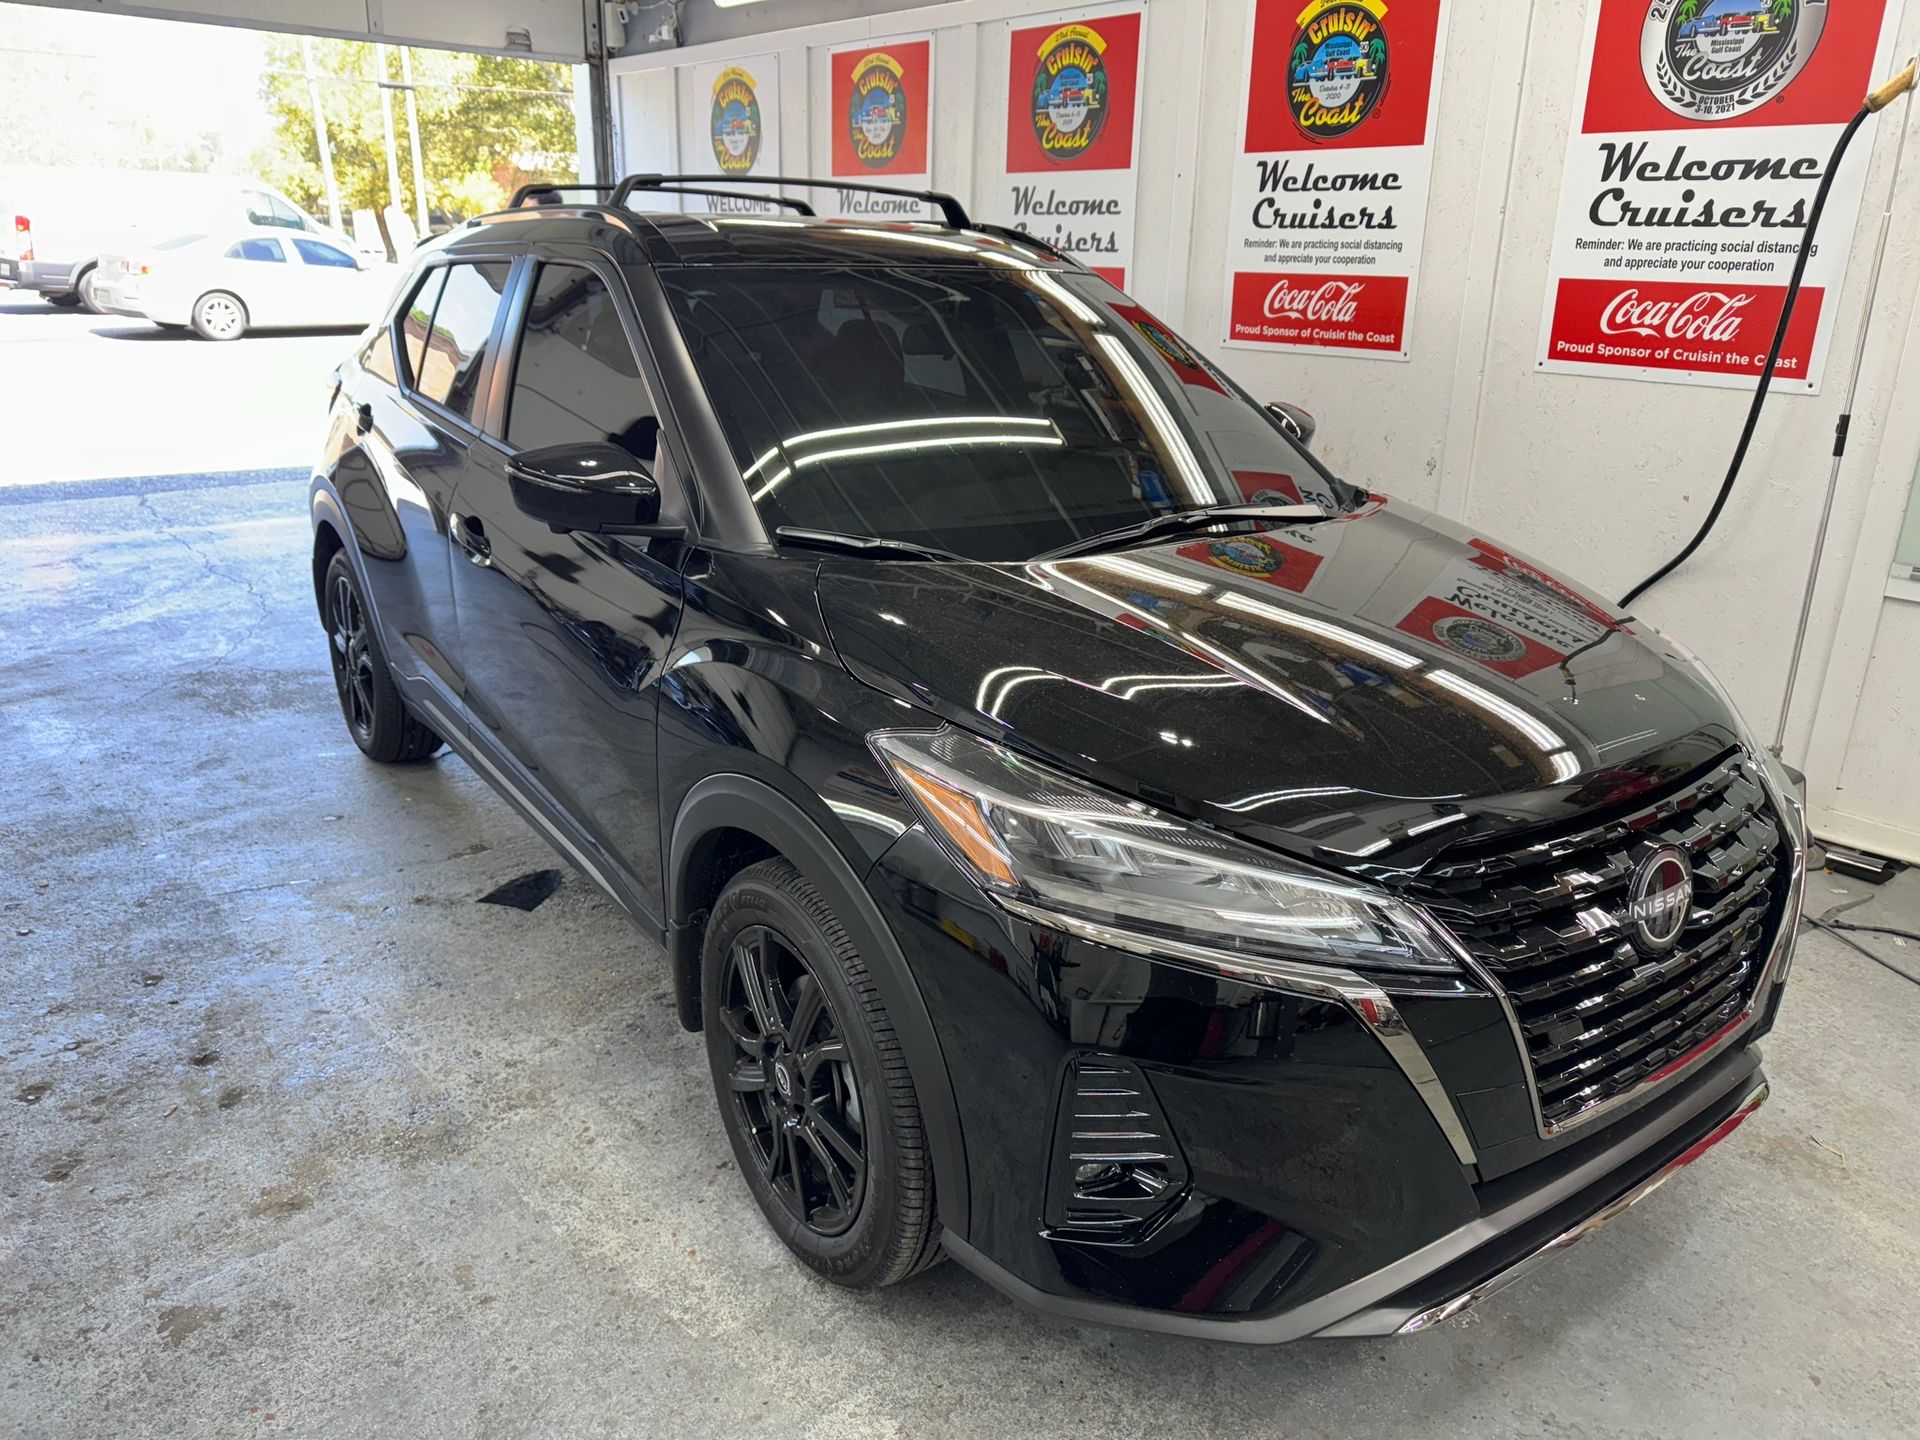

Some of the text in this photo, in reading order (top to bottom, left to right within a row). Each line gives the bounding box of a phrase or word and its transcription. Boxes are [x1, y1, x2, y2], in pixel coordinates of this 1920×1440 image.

[1308, 8, 1377, 45] Cruisin'
[1711, 38, 1745, 46] Mississippi
[1711, 46, 1723, 54] Gulf
[1675, 43, 1763, 80] The Coast
[1292, 87, 1364, 127] The Coast
[1695, 103, 1735, 115] 3-10, 2021
[1698, 94, 1735, 105] OCTOBER
[1042, 120, 1092, 149] Coast
[1256, 160, 1403, 193] Welcome
[1598, 142, 1823, 183] Welcome
[837, 188, 921, 214] Welcome
[1011, 186, 1121, 216] Welcome
[1252, 197, 1398, 230] Cruisers
[1589, 187, 1807, 228] Cruisers
[1244, 238, 1403, 253] Reminder: We are practicing social distancing
[1264, 253, 1376, 266] and appreciate your cooperation
[1575, 238, 1818, 257] Reminder: We are practicing social distancg
[1604, 256, 1775, 273] and appreciate your cooperation
[1263, 279, 1367, 323] Coca-Cola
[1600, 288, 1757, 342] Coca-Cola
[1235, 323, 1395, 344] Proud Sponsor of Cruisin' the Coast
[1557, 340, 1798, 369] Proud Sponsor of Cruisin' the Cast
[1634, 883, 1692, 919] NISSAN
